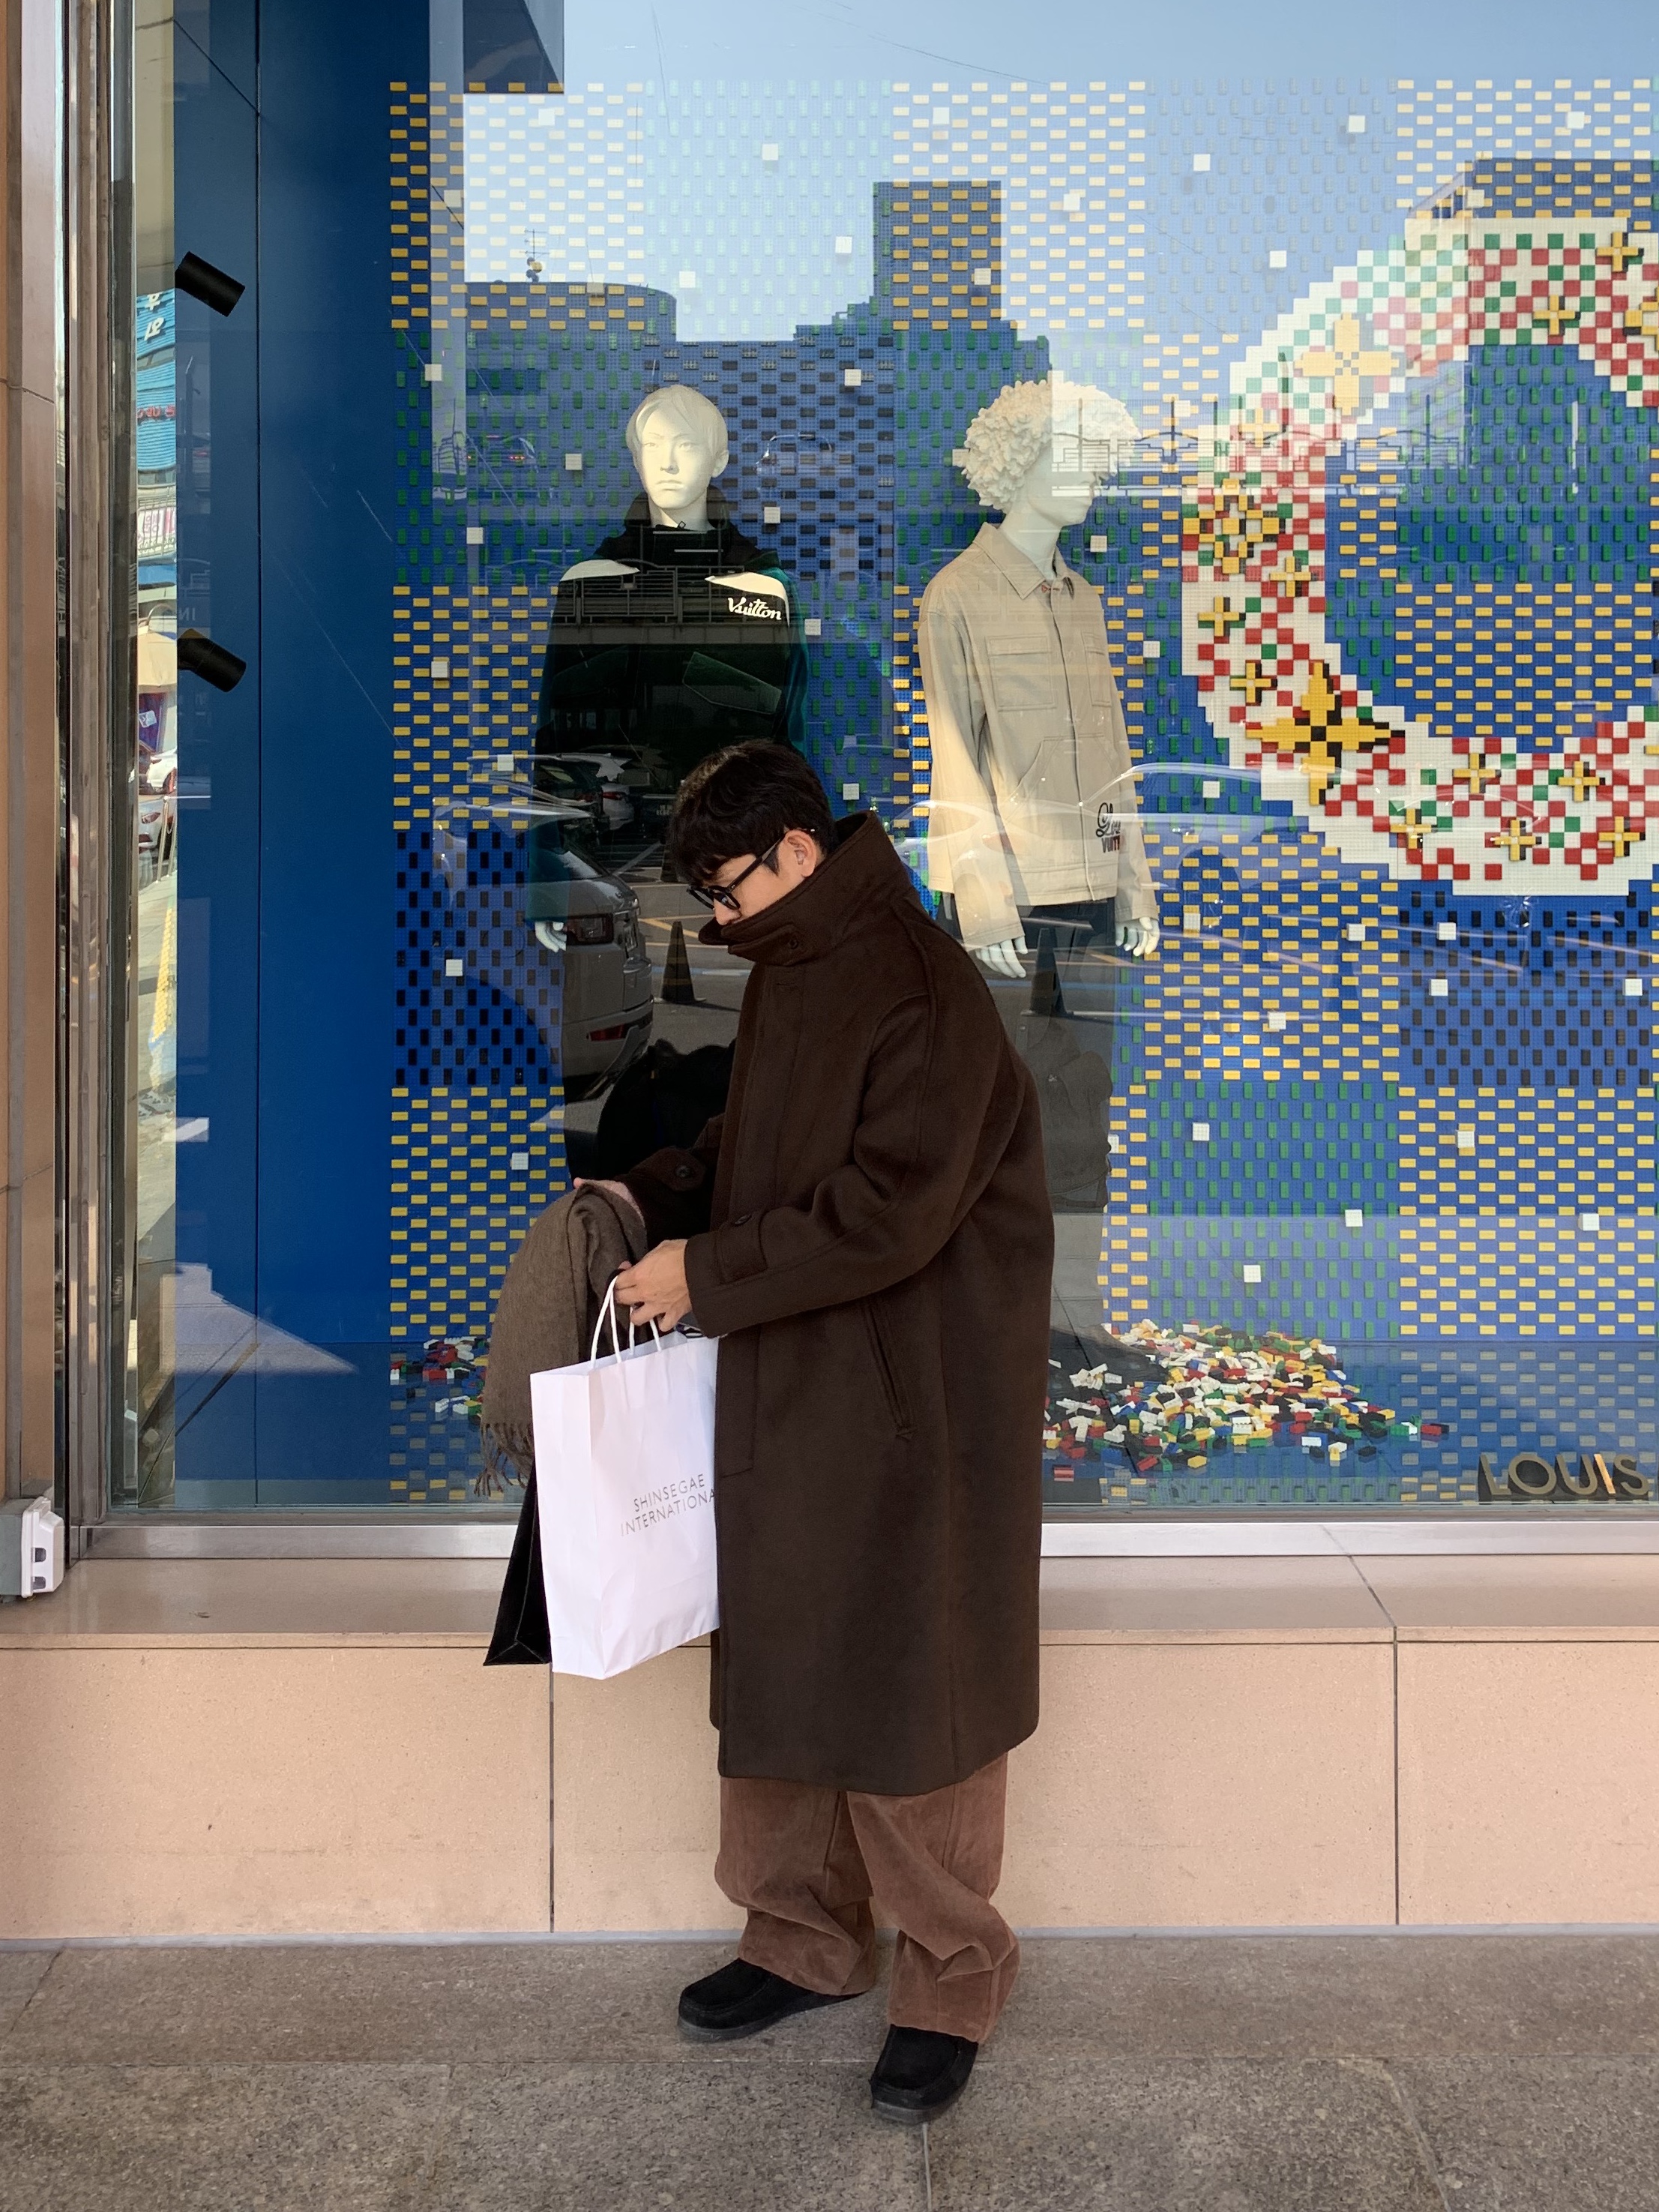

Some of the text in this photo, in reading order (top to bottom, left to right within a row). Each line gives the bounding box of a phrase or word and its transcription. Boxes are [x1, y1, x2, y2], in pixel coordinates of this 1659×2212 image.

[727, 597, 782, 620] Vuitton
[633, 1473, 705, 1512] SHINSEGAE
[1479, 1453, 1649, 1498] LOUIS
